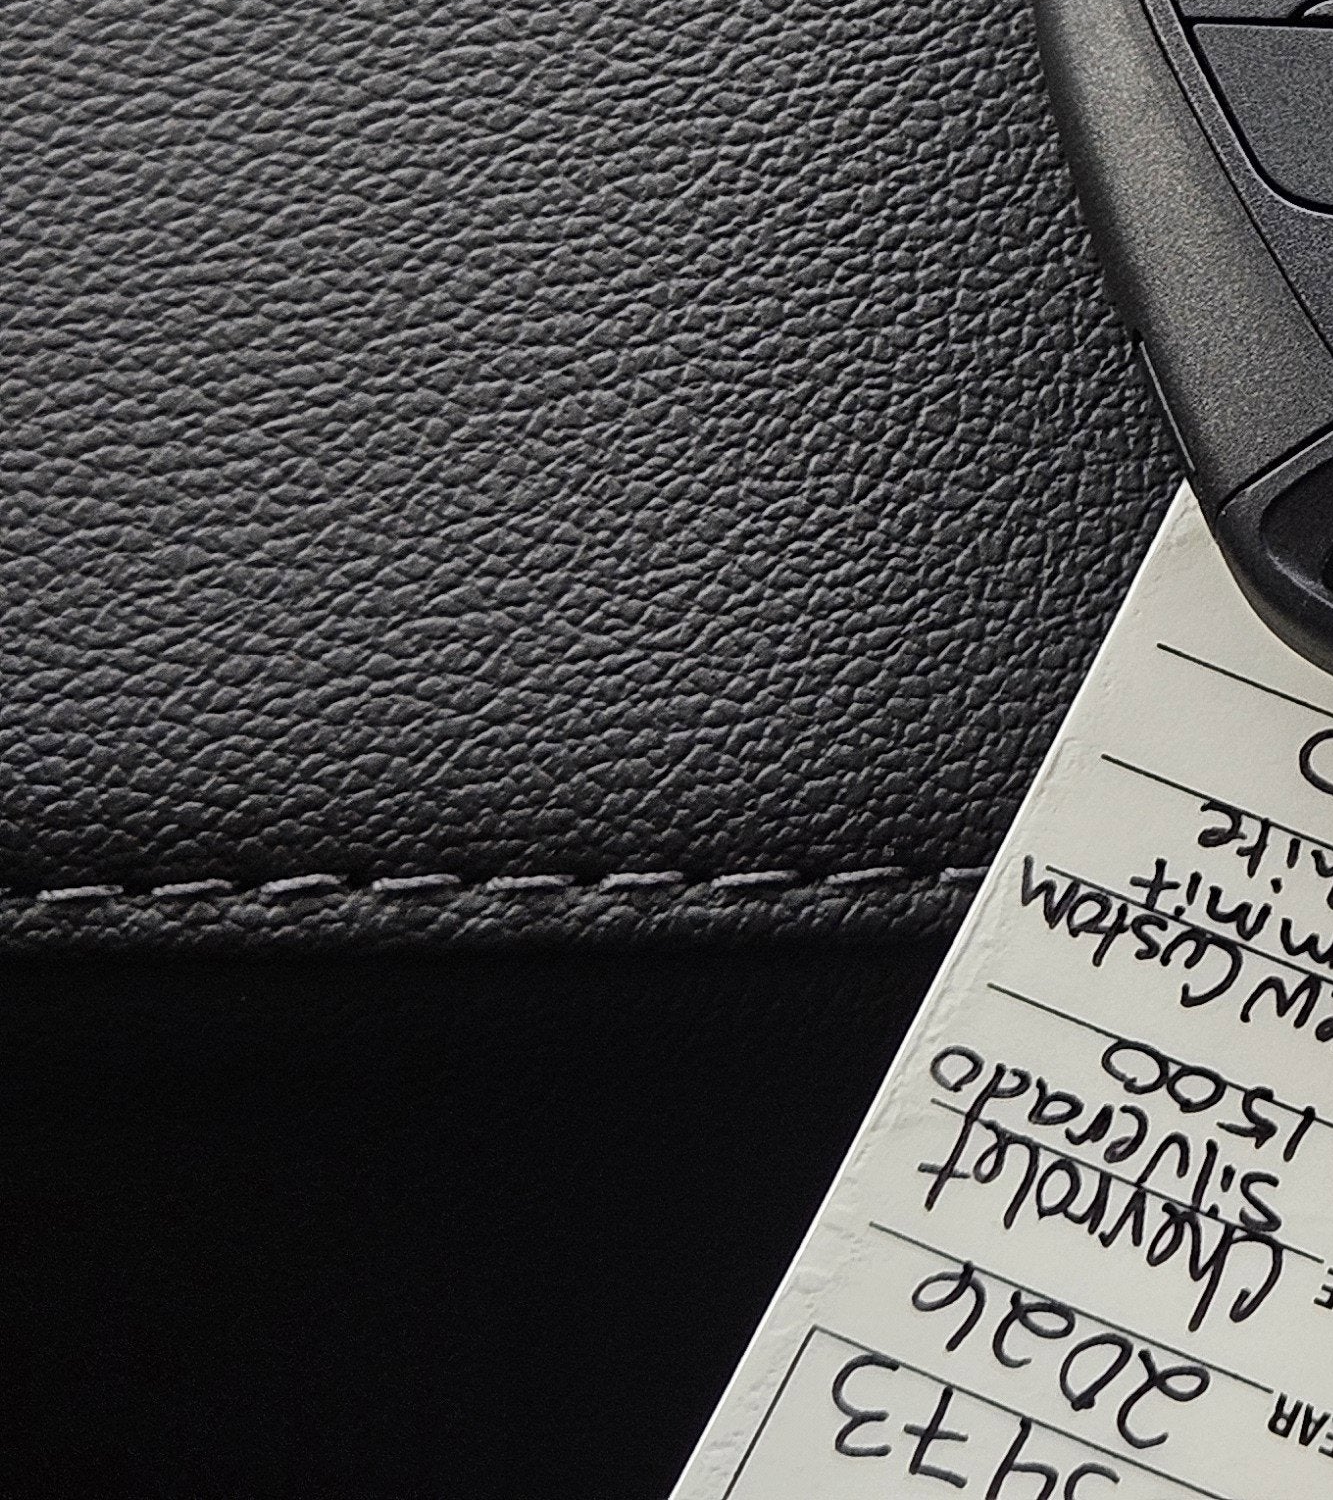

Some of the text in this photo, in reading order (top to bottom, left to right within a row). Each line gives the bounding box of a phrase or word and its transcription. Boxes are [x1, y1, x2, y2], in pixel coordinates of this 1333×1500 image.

[1020, 855, 1243, 1007] Custom
[1101, 1038, 1317, 1161] 1500
[918, 1104, 1286, 1332] Chevrolet
[911, 1261, 1211, 1449] 2026
